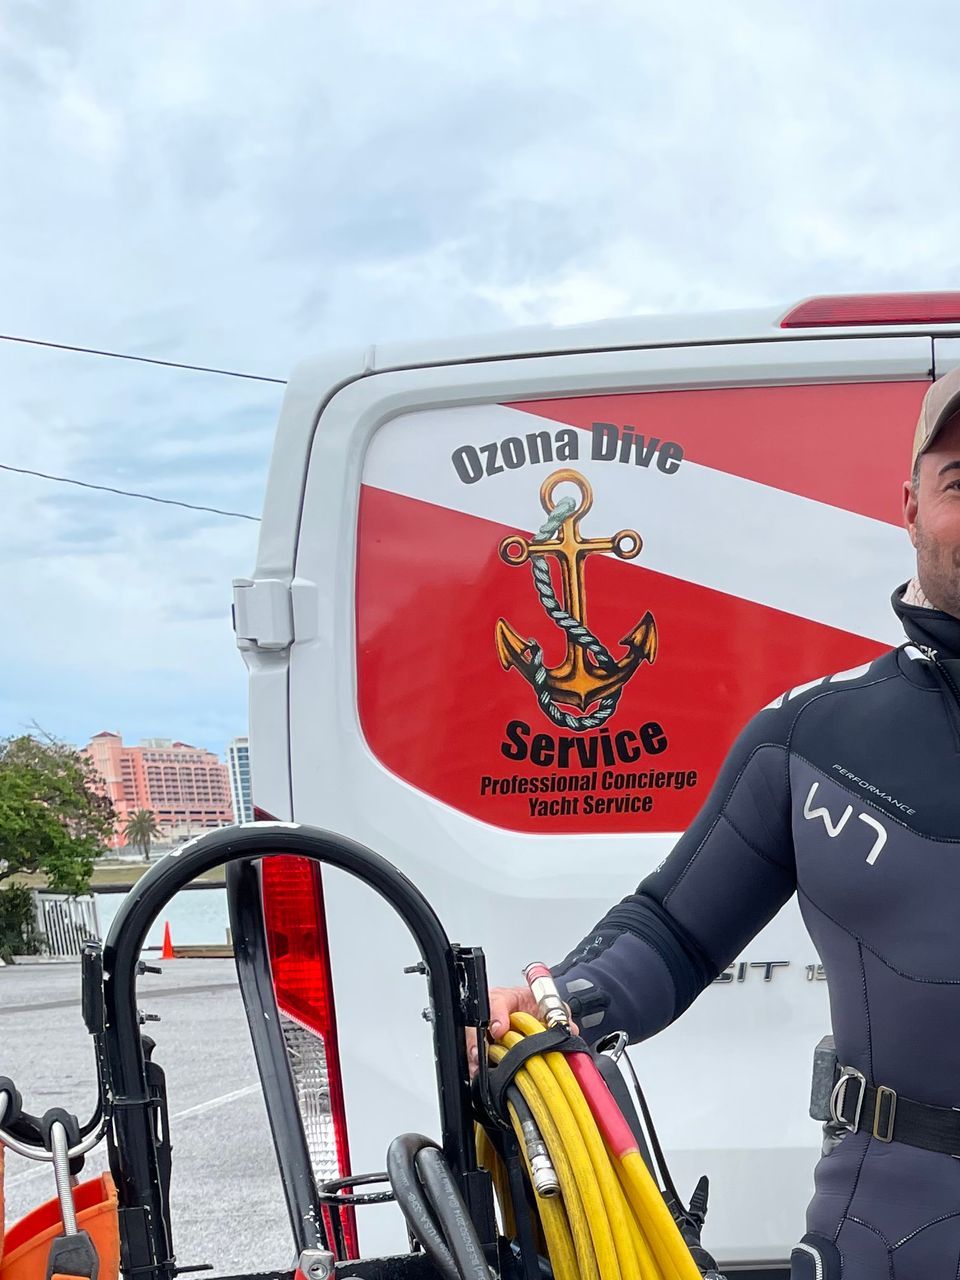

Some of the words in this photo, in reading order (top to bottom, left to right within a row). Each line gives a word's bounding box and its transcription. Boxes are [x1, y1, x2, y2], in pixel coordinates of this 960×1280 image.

[451, 428, 579, 485] Ozona
[591, 422, 684, 475] Dive
[501, 719, 668, 769] Service
[480, 772, 597, 796] Professional
[601, 769, 697, 790] Concierge
[832, 763, 917, 816] PERFORMANCE
[528, 797, 579, 817] Yacht
[583, 794, 653, 815] Service
[712, 961, 790, 984] SIT
